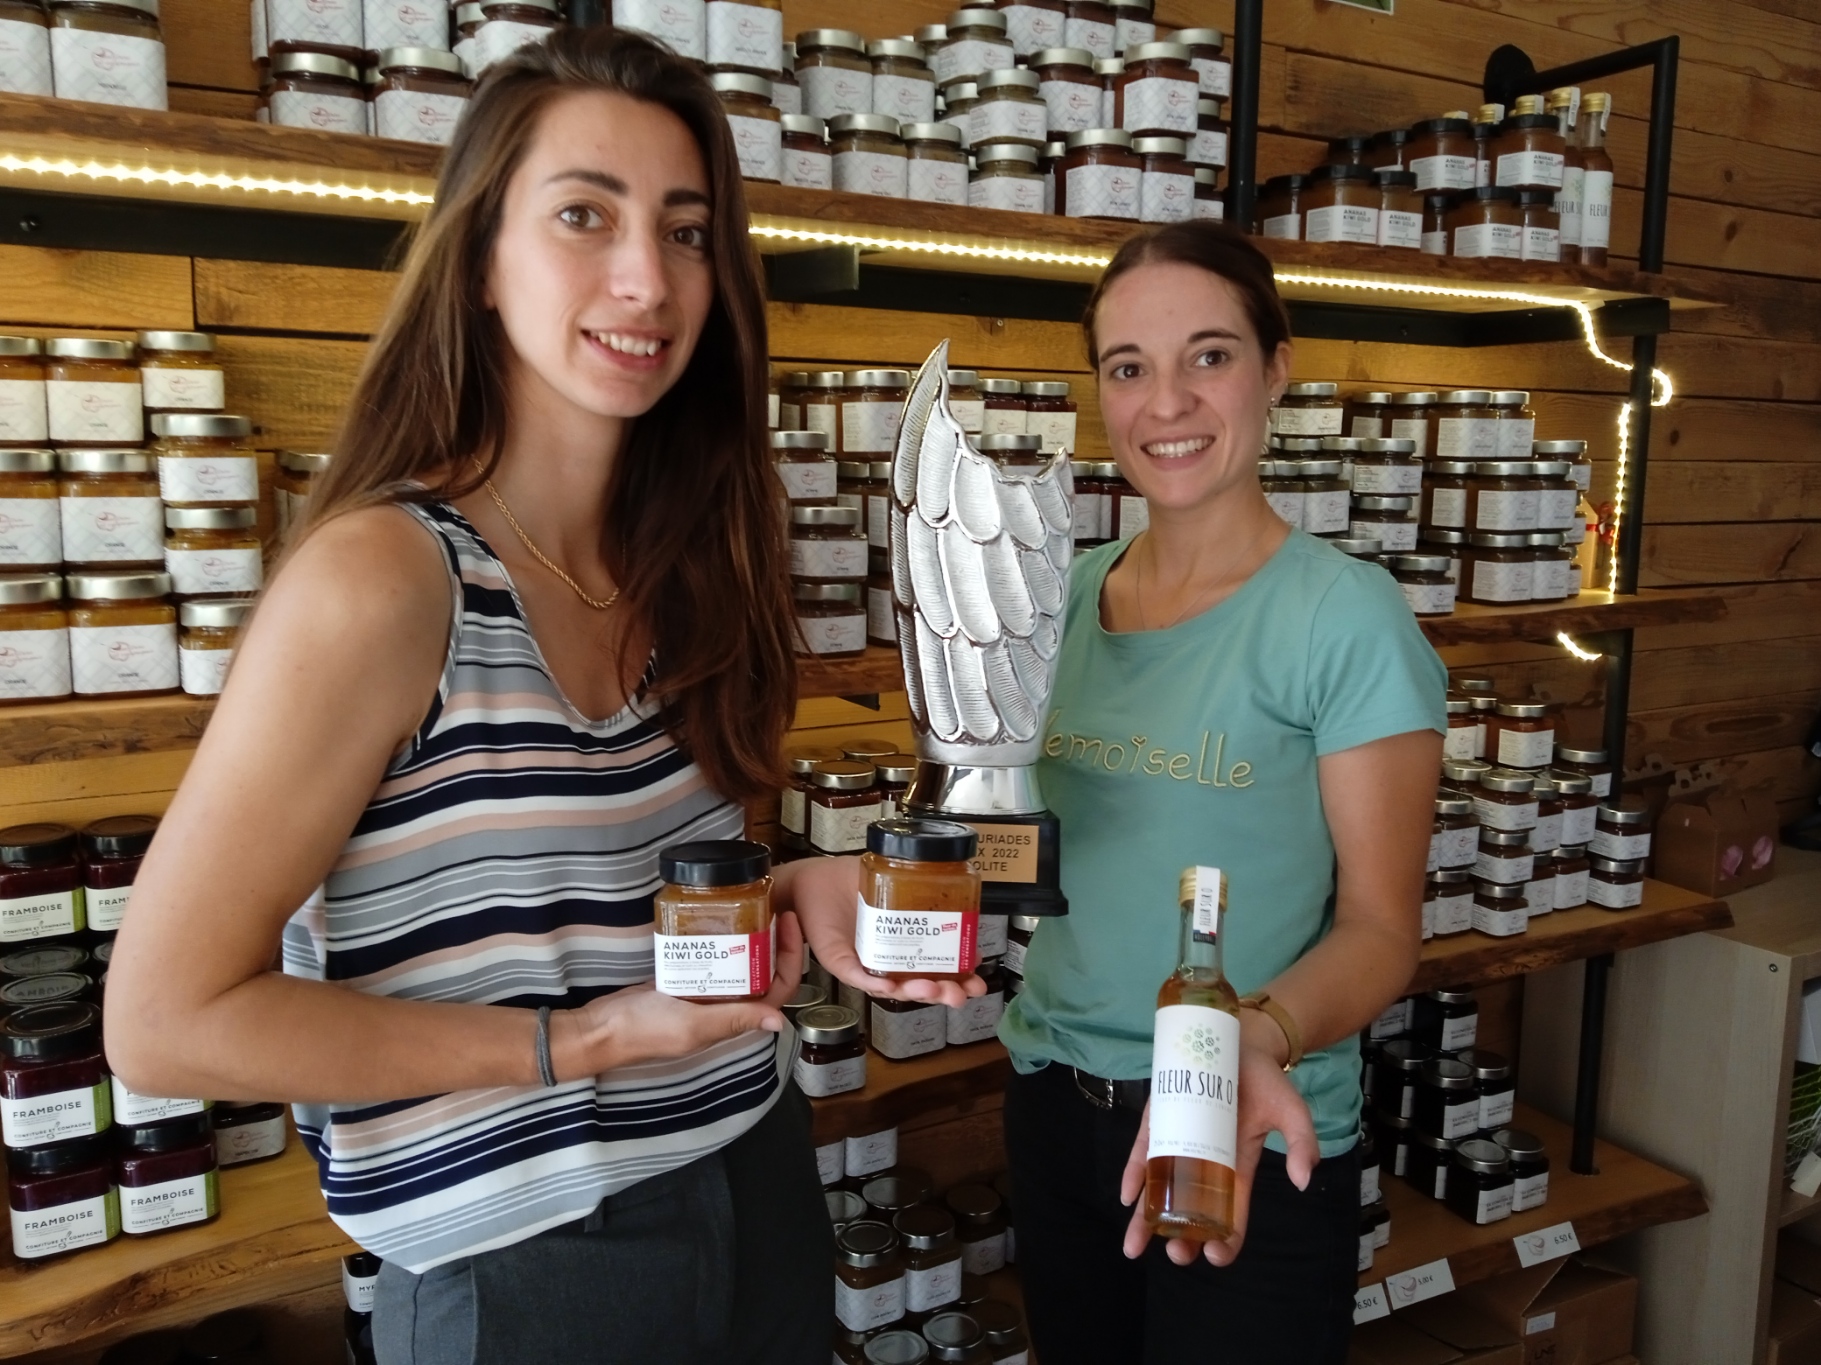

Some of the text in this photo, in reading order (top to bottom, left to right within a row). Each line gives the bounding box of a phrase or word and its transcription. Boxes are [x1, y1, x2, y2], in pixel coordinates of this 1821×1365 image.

[1589, 204, 1608, 217] FLEUR
[992, 848, 1019, 859] 2022
[970, 861, 1008, 872] OLITE
[98, 896, 130, 906] FRAM
[1200, 894, 1212, 907] SUR
[2, 903, 63, 916] FRAMBOISE
[876, 915, 929, 926] ANANAS
[1199, 908, 1211, 927] FLEUR
[875, 925, 903, 935] KIWI
[907, 926, 941, 936] GOLD
[663, 941, 716, 950] ANANAS
[664, 951, 729, 960] KIWI GOLD
[873, 953, 908, 961] CONFITURE
[1158, 1069, 1192, 1094] FLEUR
[1197, 1071, 1223, 1102] SUR
[13, 1100, 82, 1118] FRAMBOISE
[130, 1188, 195, 1206] FRAMBOISE
[24, 1210, 94, 1231] FRAMBOISE
[131, 1216, 162, 1225] CONFITURE
[171, 1207, 204, 1218] COMPAGNIE
[25, 1239, 59, 1250] CONFITURE
[69, 1229, 103, 1241] COMPAGNIE
[1554, 1232, 1573, 1244] 6.50 €
[1357, 1296, 1378, 1309] 6.50 €
